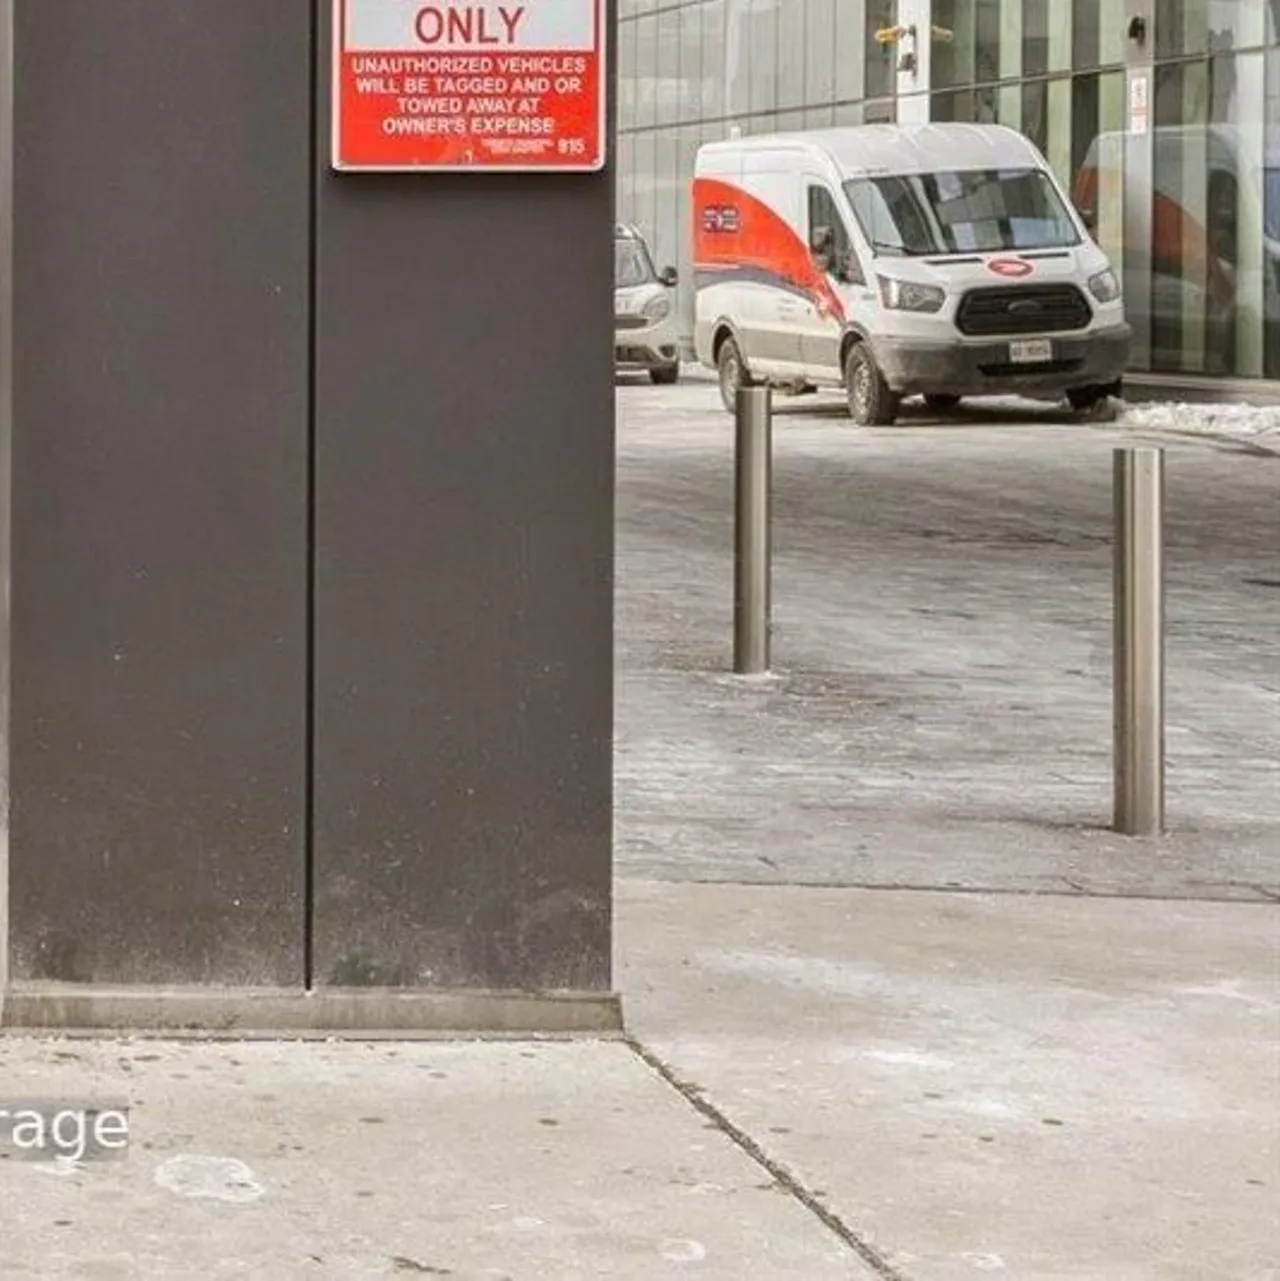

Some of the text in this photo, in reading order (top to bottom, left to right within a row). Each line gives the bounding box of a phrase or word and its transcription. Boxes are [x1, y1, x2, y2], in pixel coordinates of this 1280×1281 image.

[414, 7, 525, 44] ONLY
[351, 57, 587, 72] UNAUTHORIZED VEHICLES
[355, 77, 582, 94] WILL BE TAGGED AND OR
[397, 97, 541, 113] TOWED AWAY AT
[382, 117, 555, 134] OWNER'S EXPENSE
